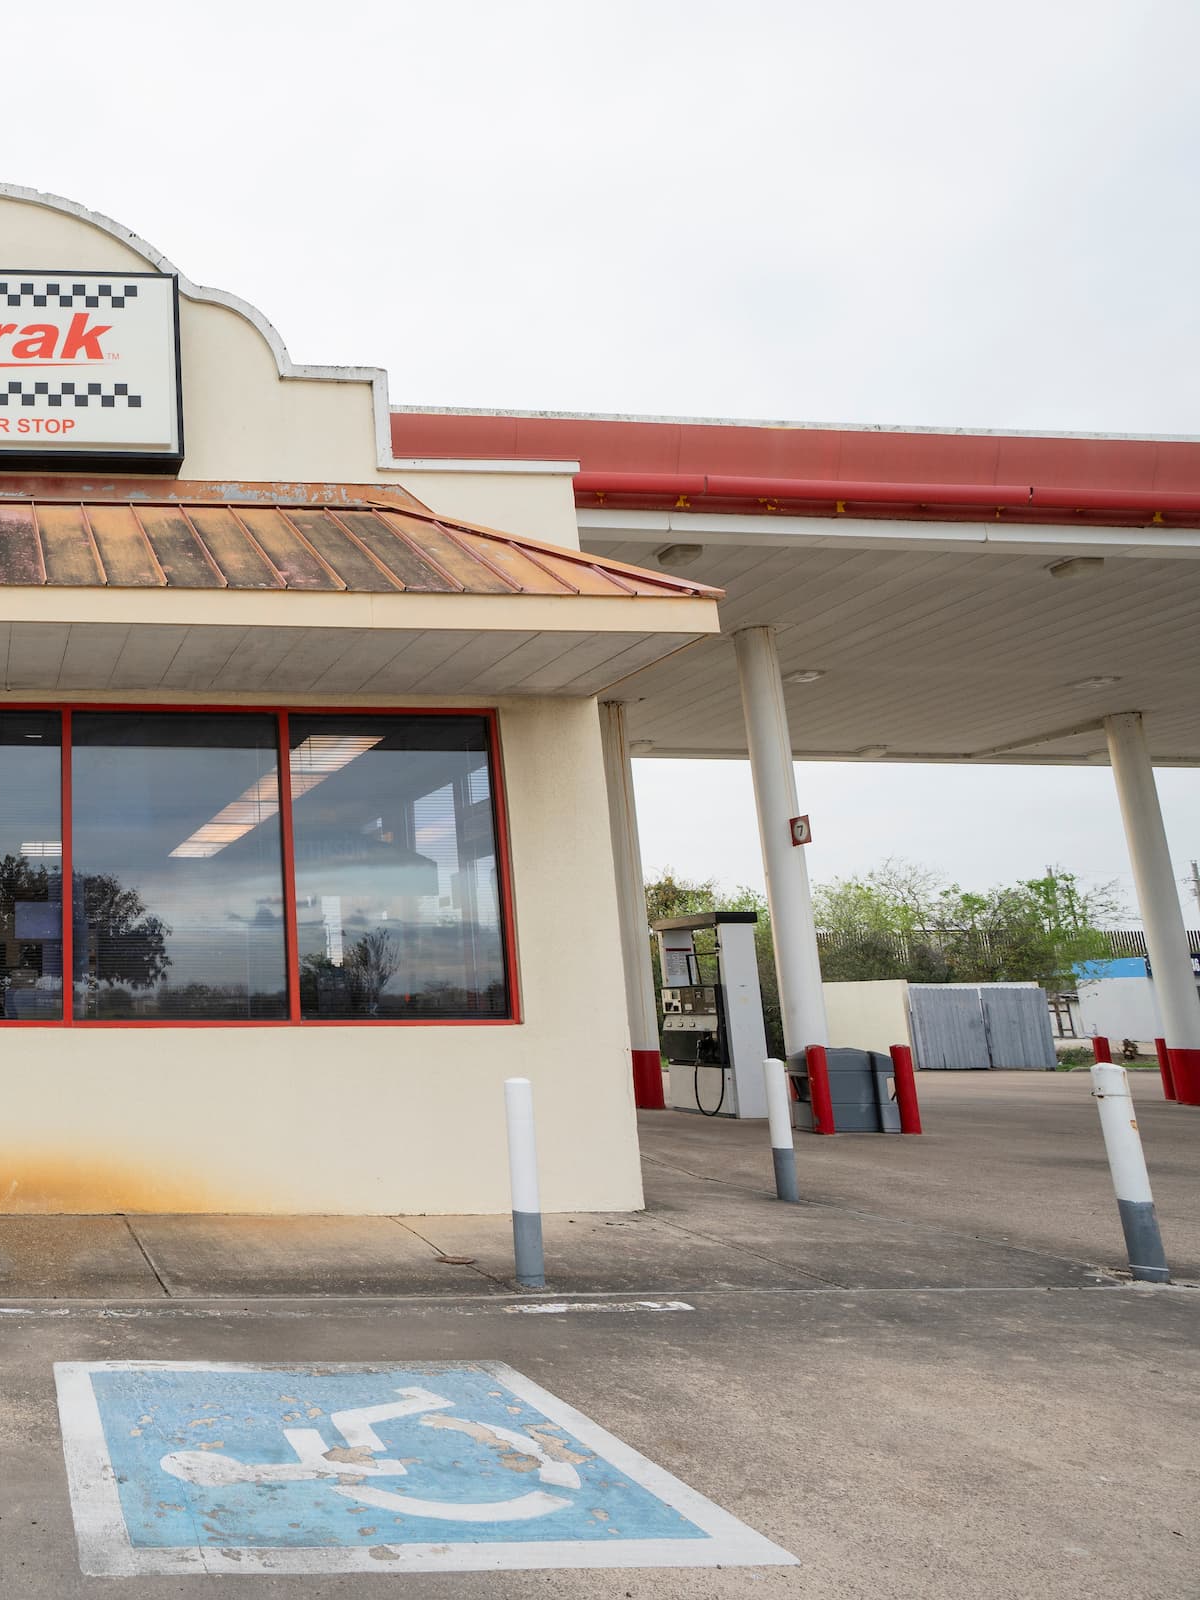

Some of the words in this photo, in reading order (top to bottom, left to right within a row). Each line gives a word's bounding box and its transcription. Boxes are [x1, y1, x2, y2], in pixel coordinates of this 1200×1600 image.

[106, 352, 120, 361] TM
[17, 418, 75, 434] STOP
[796, 824, 804, 837] 7
